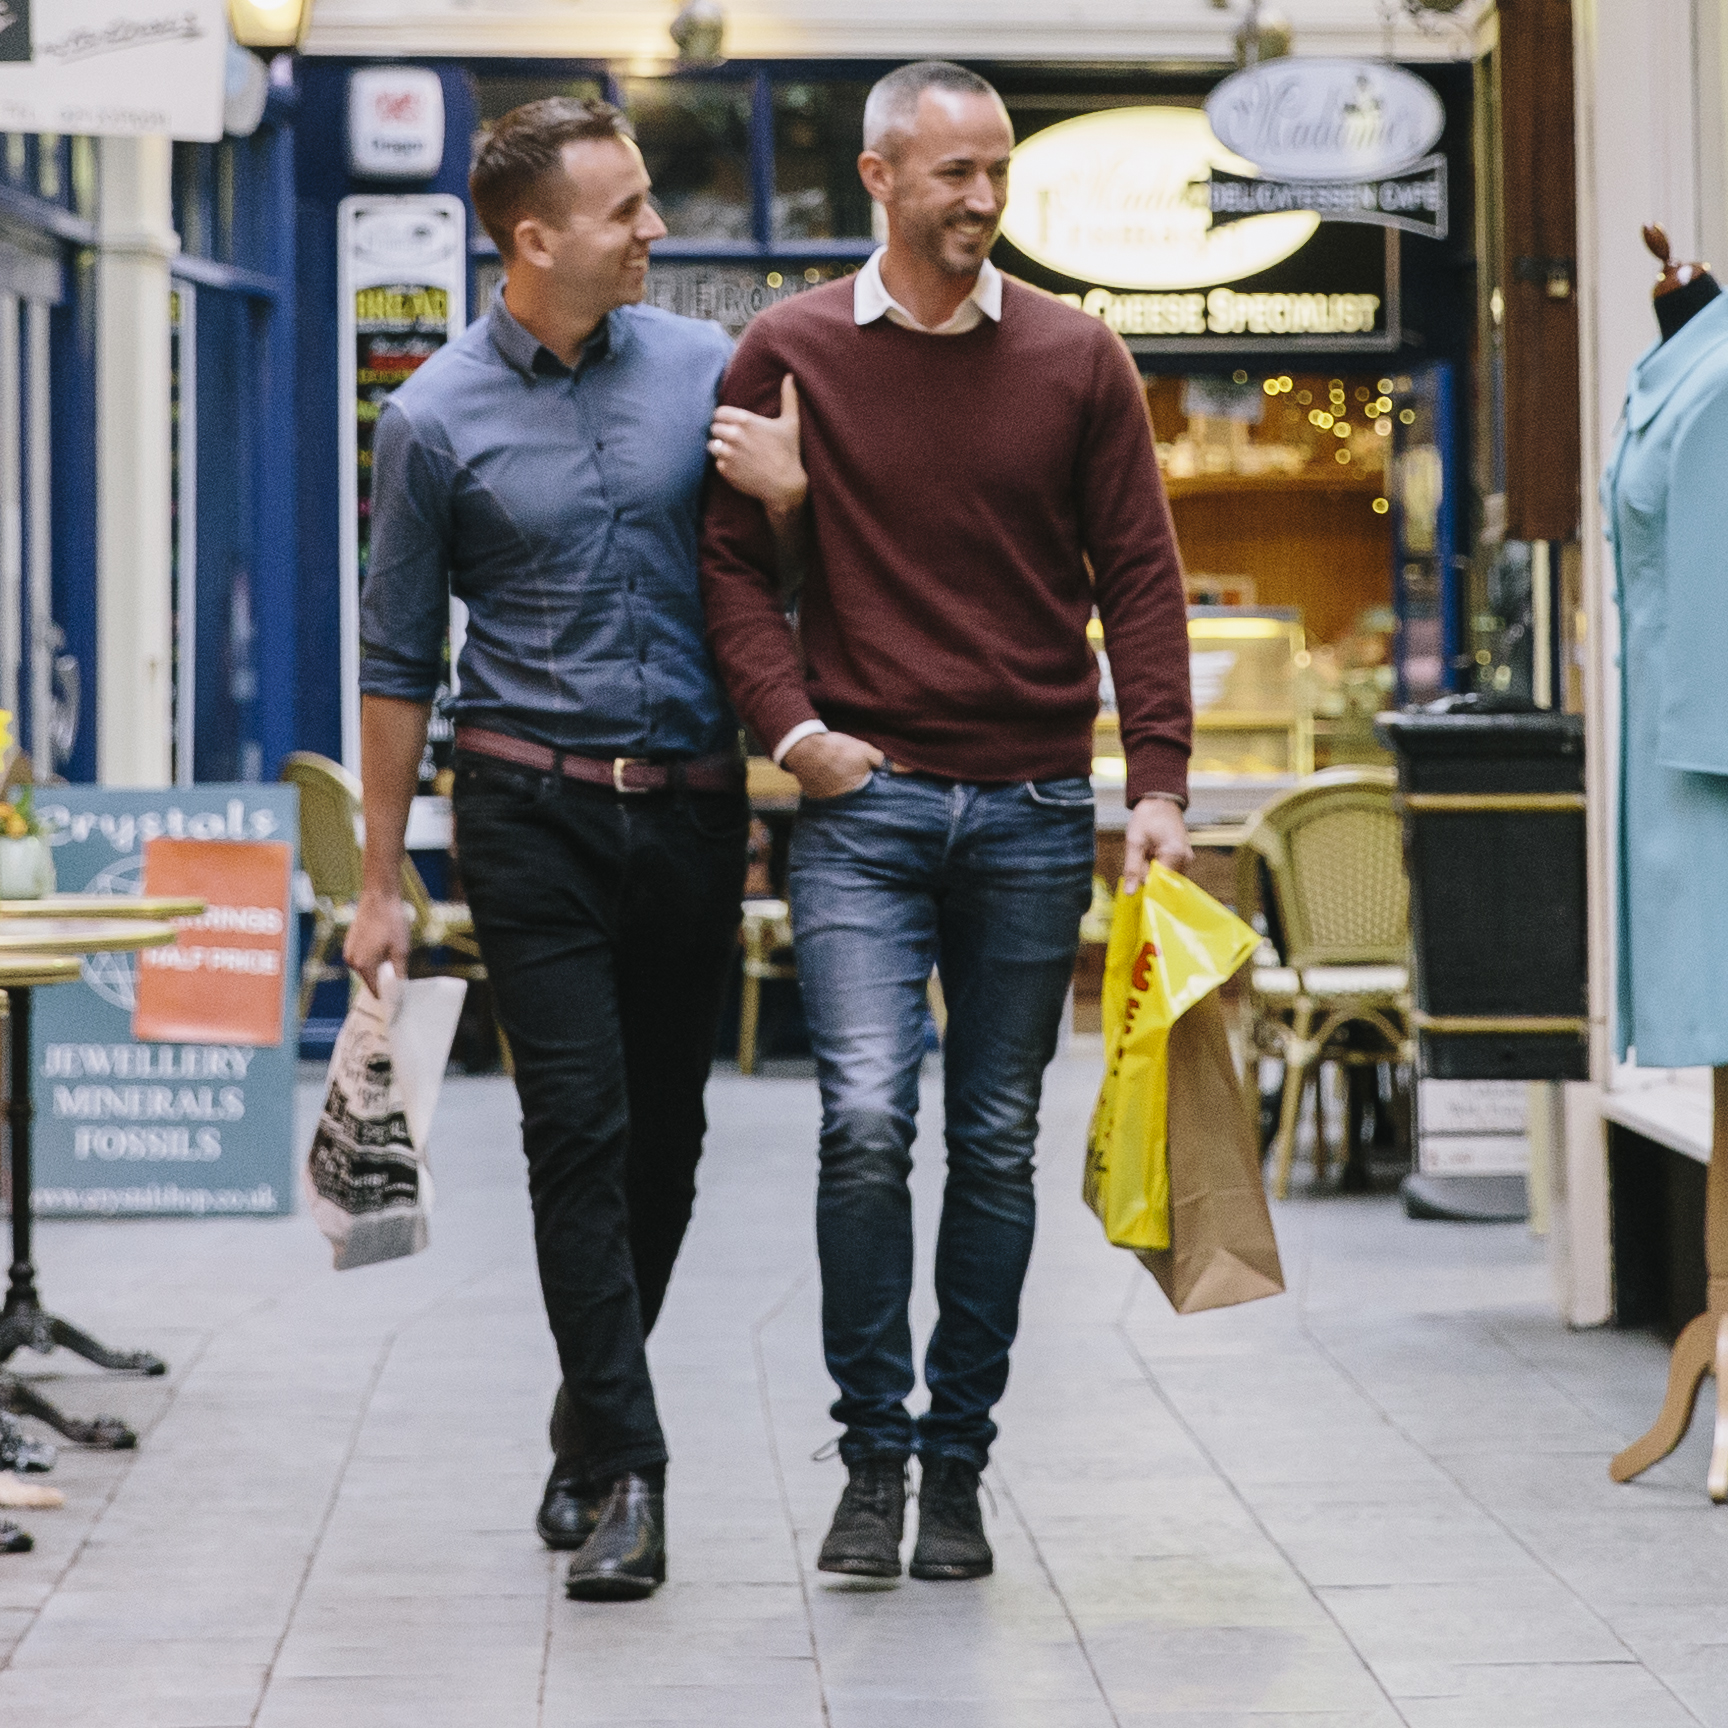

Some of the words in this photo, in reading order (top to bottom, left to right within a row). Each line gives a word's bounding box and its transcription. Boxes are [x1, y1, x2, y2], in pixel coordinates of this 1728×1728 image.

[37, 799, 277, 850] Crystals
[142, 944, 204, 971] HALF
[206, 946, 282, 976] PRICE
[41, 1043, 255, 1080] JEWELLERY
[52, 1084, 246, 1121] MINERALS
[74, 1124, 223, 1162] FOSSILS
